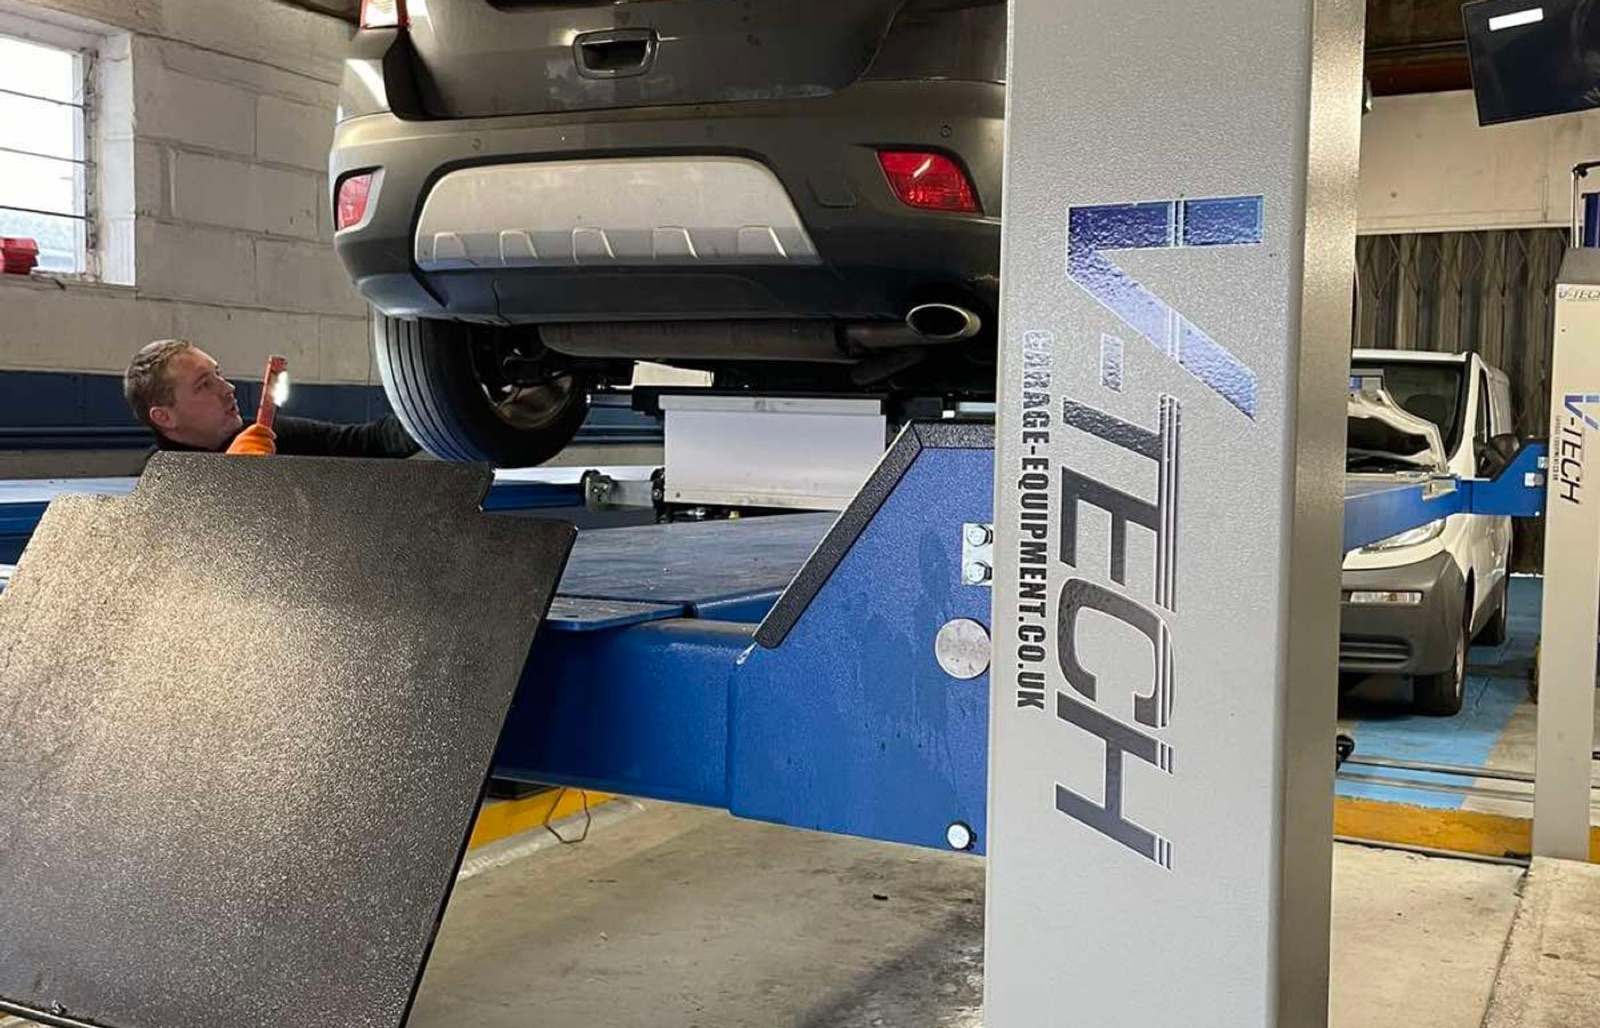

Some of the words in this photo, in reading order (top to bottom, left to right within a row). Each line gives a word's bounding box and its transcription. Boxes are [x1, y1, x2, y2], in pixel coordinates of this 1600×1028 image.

[1017, 329, 1052, 710] GARAGE-EQUIPMENT.CO.UK
[1054, 195, 1264, 871] V-TECH
[1560, 395, 1600, 504] V-TECH
